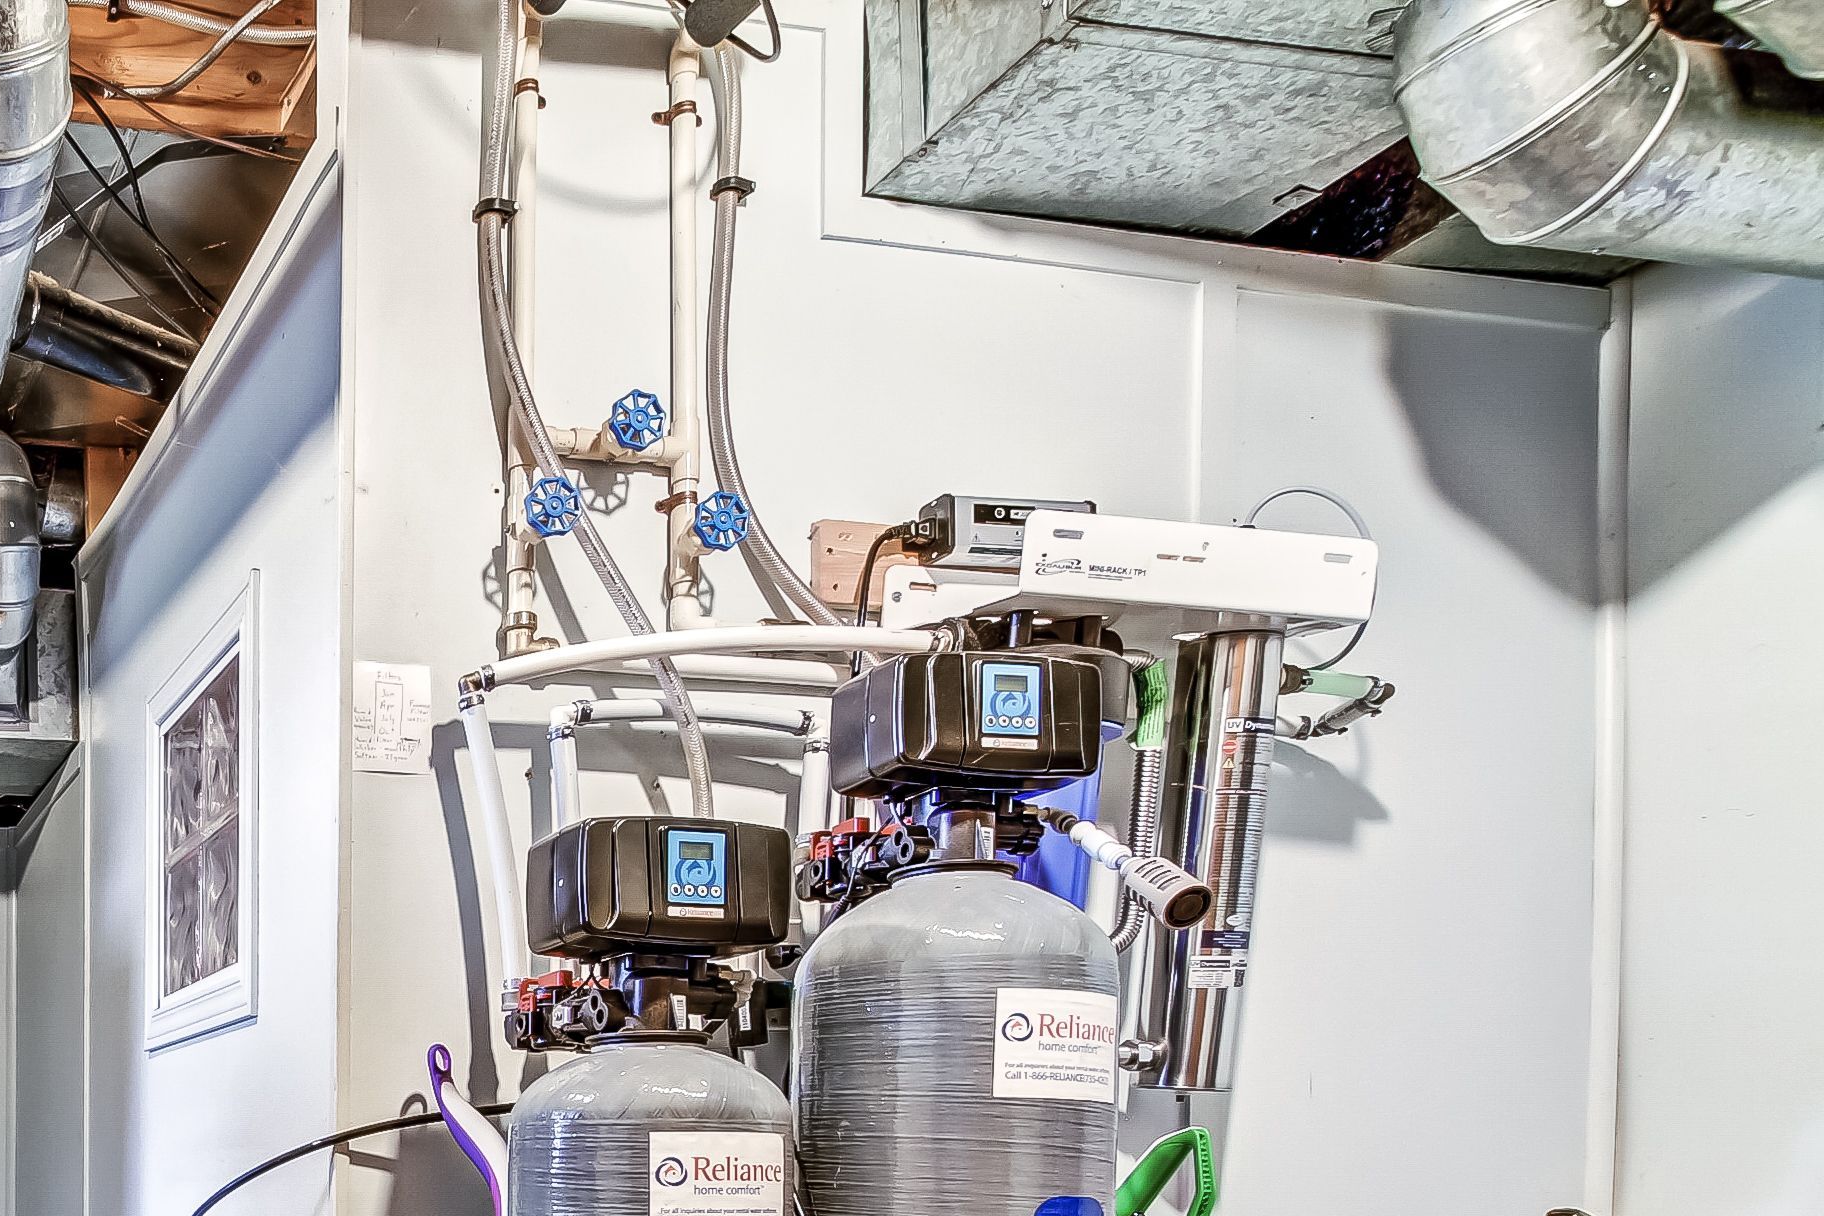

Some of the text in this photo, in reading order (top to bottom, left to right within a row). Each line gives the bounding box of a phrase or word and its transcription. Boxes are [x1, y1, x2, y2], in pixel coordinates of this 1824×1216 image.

[1037, 1013, 1115, 1045] Reliance
[1038, 1041, 1066, 1051] home
[1005, 1071, 1022, 1080] Call
[691, 1156, 782, 1183] Reliance
[694, 1184, 724, 1196] home
